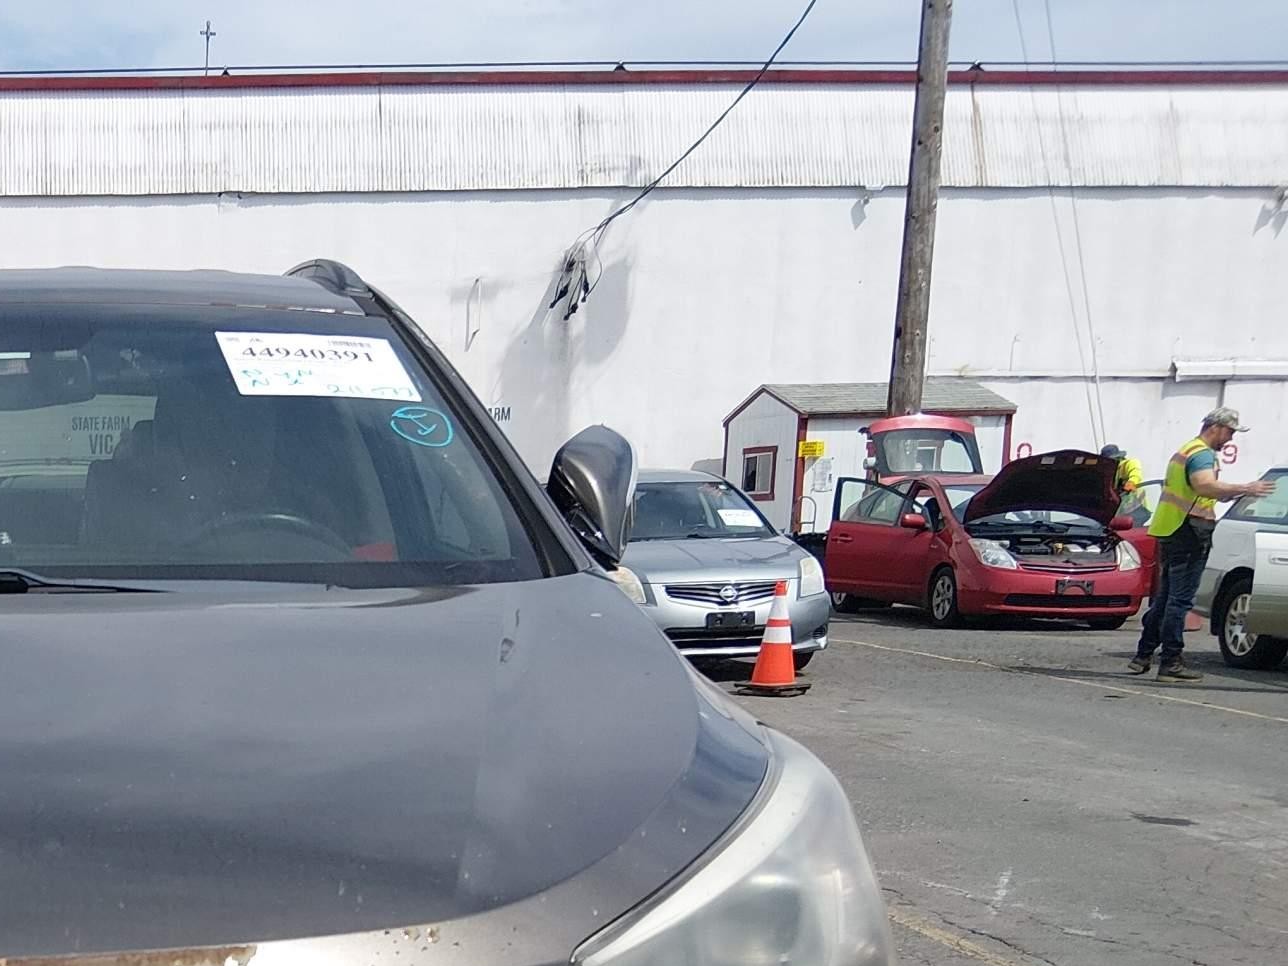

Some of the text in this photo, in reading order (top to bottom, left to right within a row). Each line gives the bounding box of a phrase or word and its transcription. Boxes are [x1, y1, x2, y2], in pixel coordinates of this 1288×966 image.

[241, 346, 374, 363] 44940391
[71, 415, 131, 431] STATE FARM
[88, 433, 114, 455] VIC
[1222, 443, 1239, 465] 9
